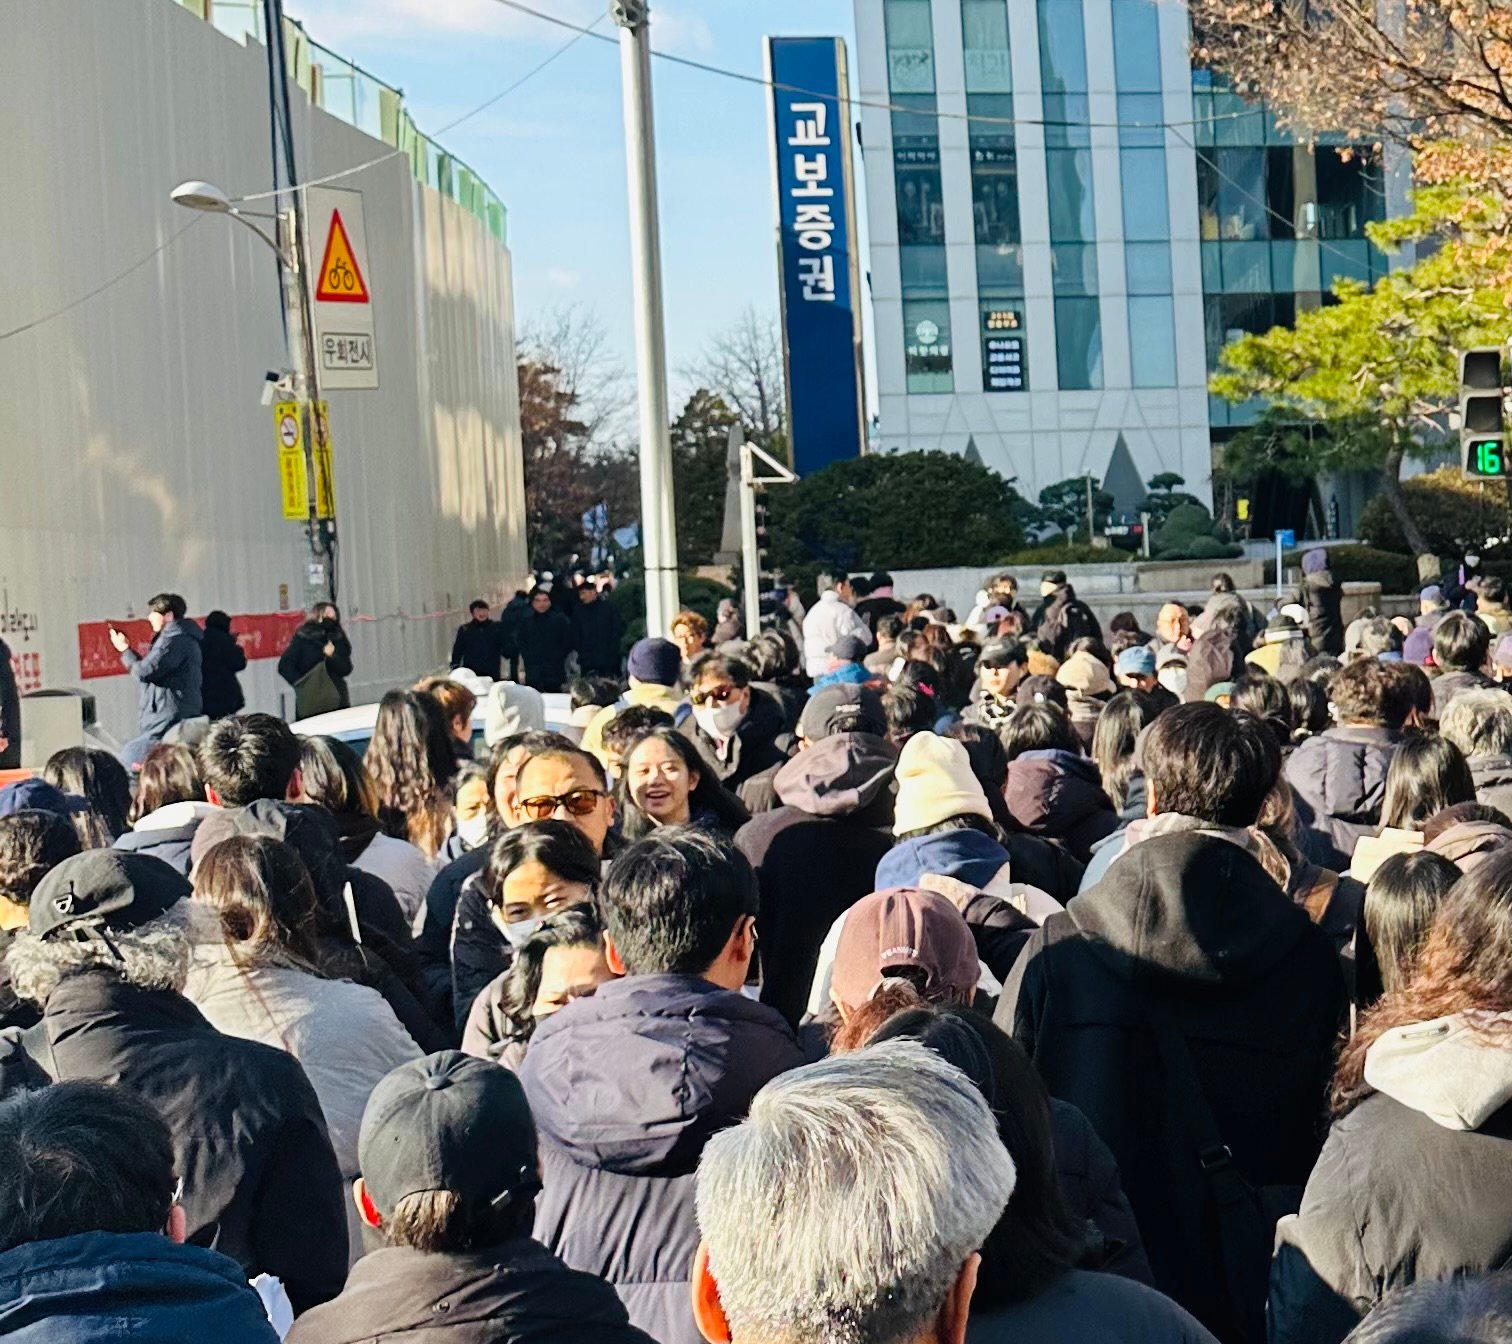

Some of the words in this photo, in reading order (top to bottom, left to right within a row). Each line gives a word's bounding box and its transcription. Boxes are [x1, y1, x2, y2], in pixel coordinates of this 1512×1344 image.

[787, 102, 836, 302] 교보증권
[325, 337, 371, 365] 우회전시
[1477, 442, 1500, 475] 16
